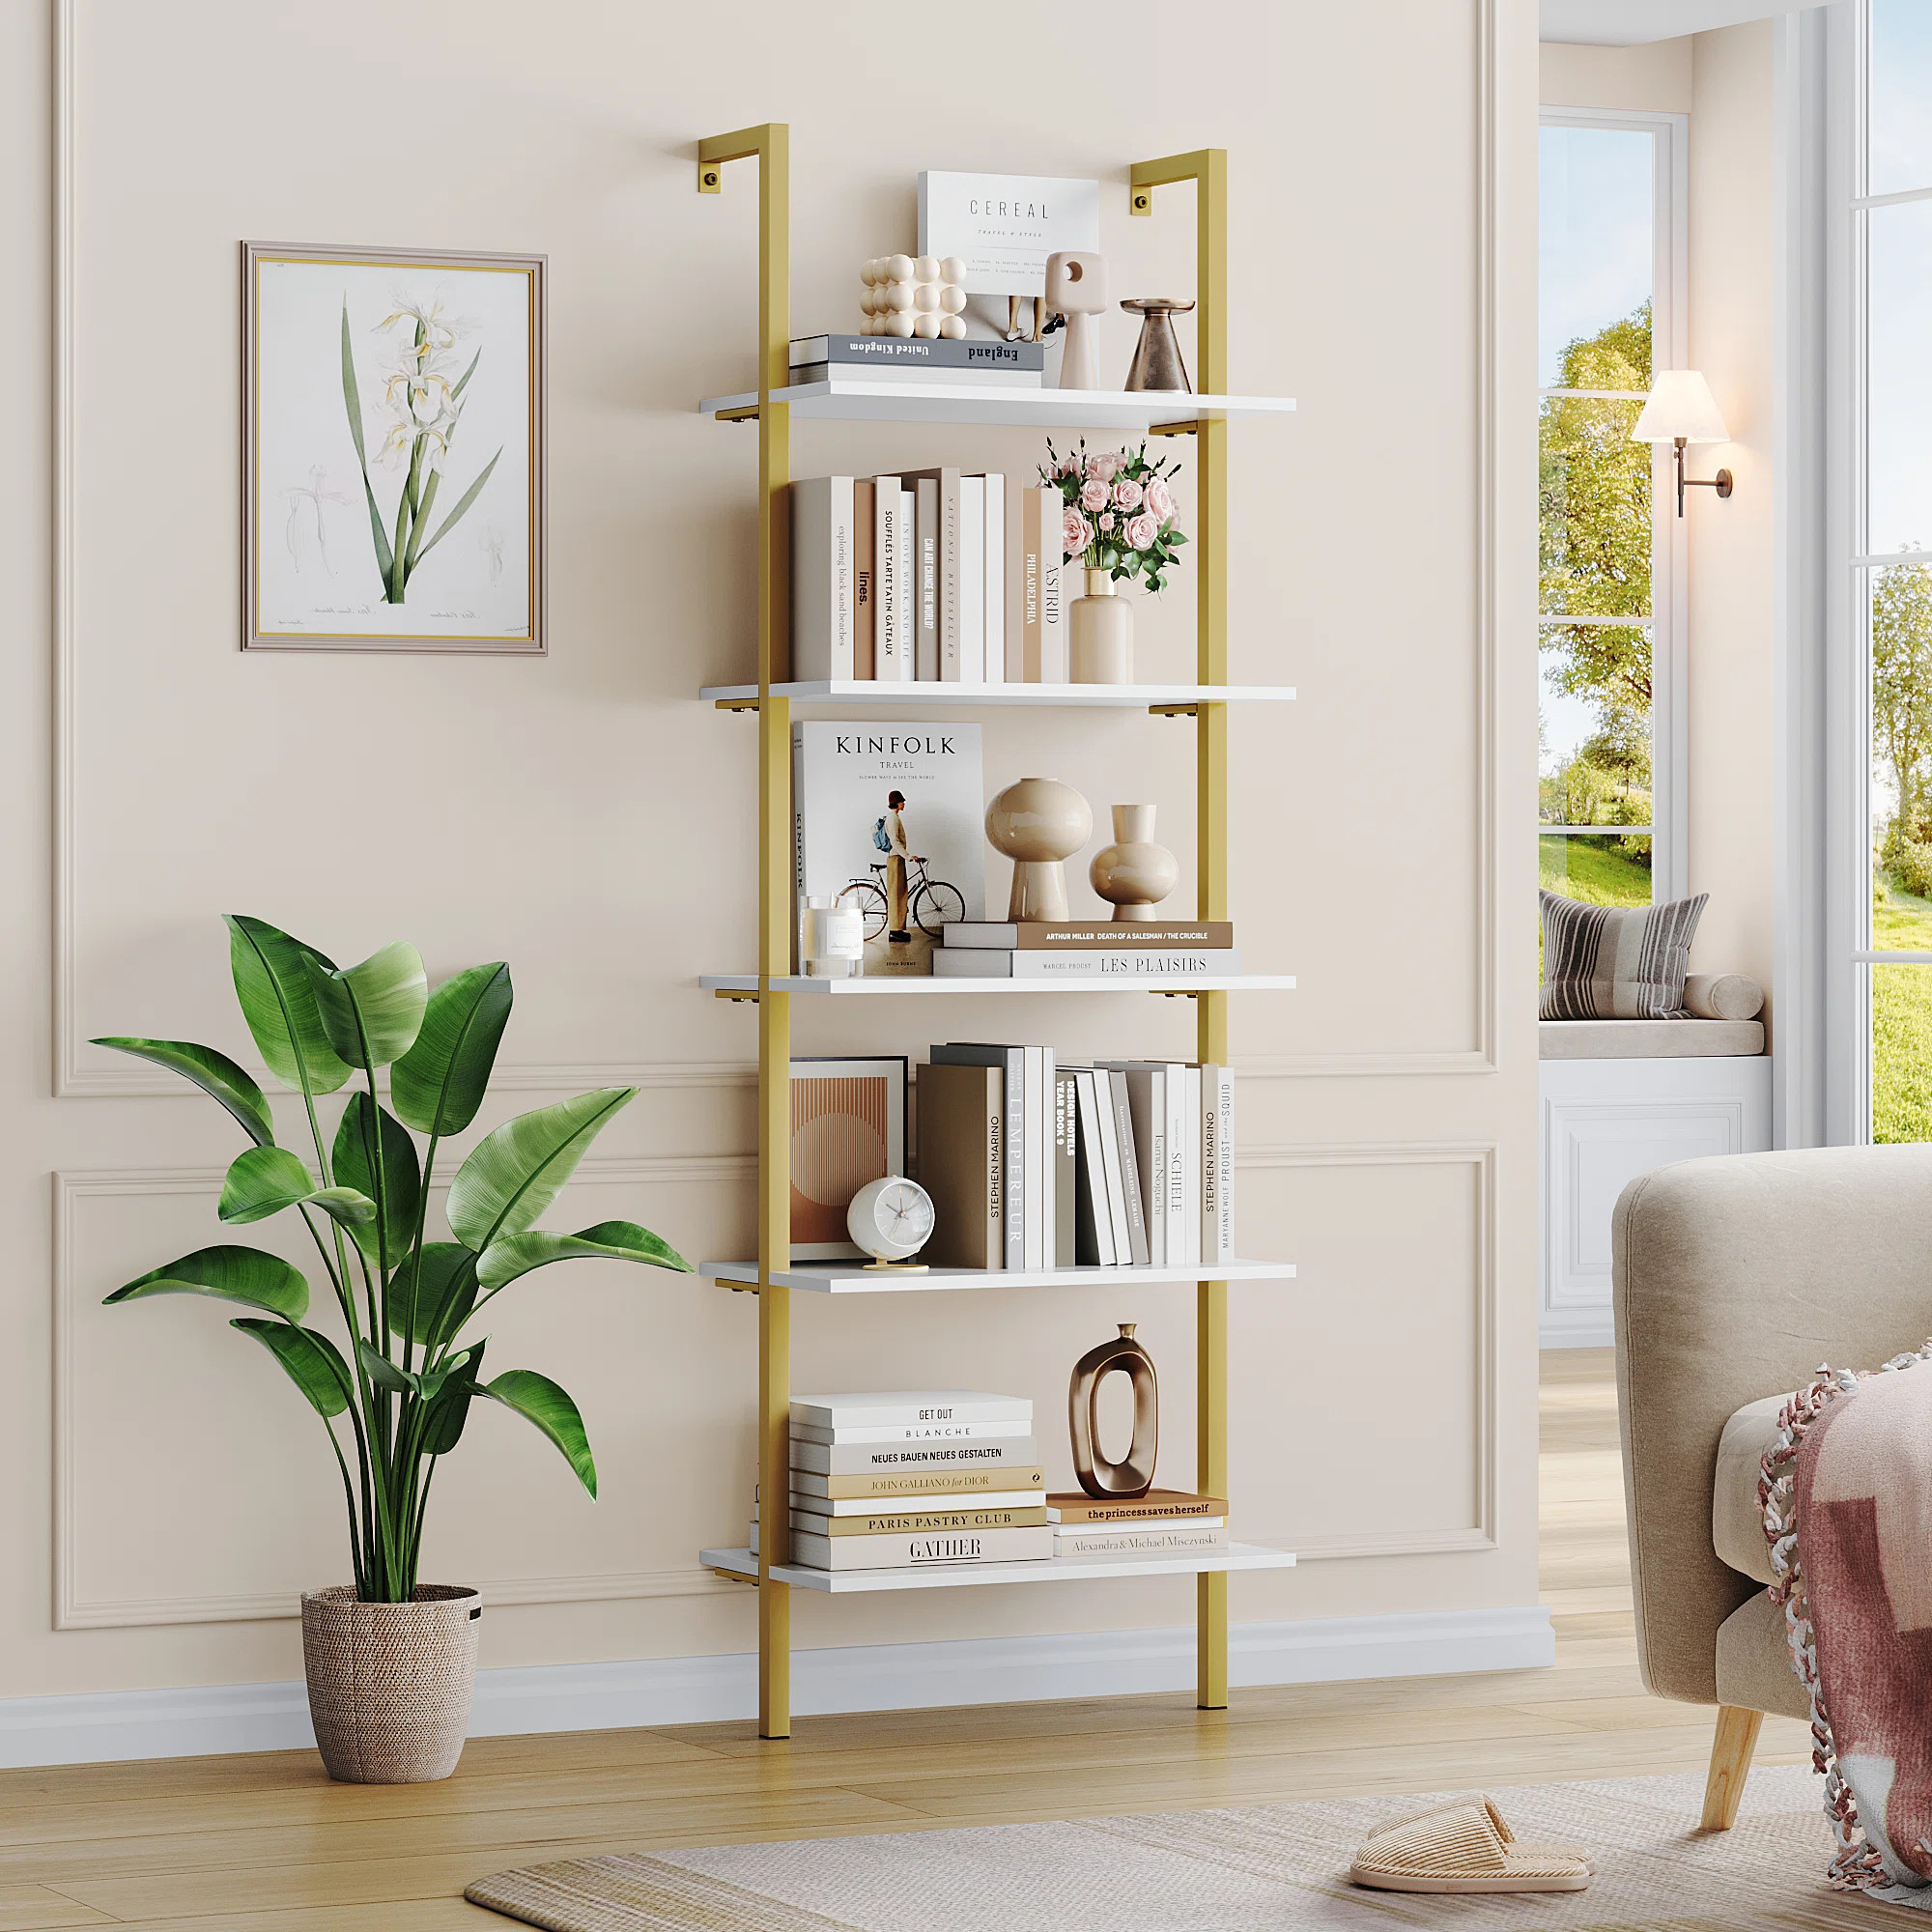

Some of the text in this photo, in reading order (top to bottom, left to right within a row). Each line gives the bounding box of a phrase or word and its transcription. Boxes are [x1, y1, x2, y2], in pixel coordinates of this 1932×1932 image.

[970, 199, 1048, 219] CEREAL
[849, 342, 929, 355] United Kingdom
[968, 346, 1019, 360] England
[885, 510, 894, 554] SOUFFLÉS
[837, 526, 847, 646] exploring black sand beaches
[859, 571, 869, 606] lines.
[923, 538, 934, 630] CAN ART CHANGE THE WORLD?
[1027, 554, 1037, 624] PHILADELPHIA
[885, 614, 895, 656] GÂTEAUX
[837, 736, 955, 754] KINFOLK
[1100, 958, 1207, 972] LES PLAISIRS
[1221, 1084, 1231, 1117] SQUID
[1066, 1080, 1075, 1156] DESIGN HOTELS
[1009, 1097, 1022, 1243] LEMPEREUR
[1206, 1112, 1214, 1212] STEPHEN MARINO
[1221, 1140, 1231, 1181] PROUST
[1153, 1135, 1164, 1216] Isamu Noguchi
[1171, 1152, 1182, 1212] SCHIELE
[920, 1408, 953, 1420] GET OUT
[906, 1428, 971, 1438] BLANCHE
[871, 1448, 1002, 1463] NEUES BAUEN NEUES GESTALTEN
[871, 1476, 989, 1491] JOHN GALLIANO for DIOR
[868, 1514, 1012, 1530] PARIS PASTRY CLUB
[1088, 1504, 1209, 1520] the princess saves herself
[910, 1538, 980, 1558] GATHER
[1072, 1534, 1217, 1552] Alexandra & Michael Misczynski
